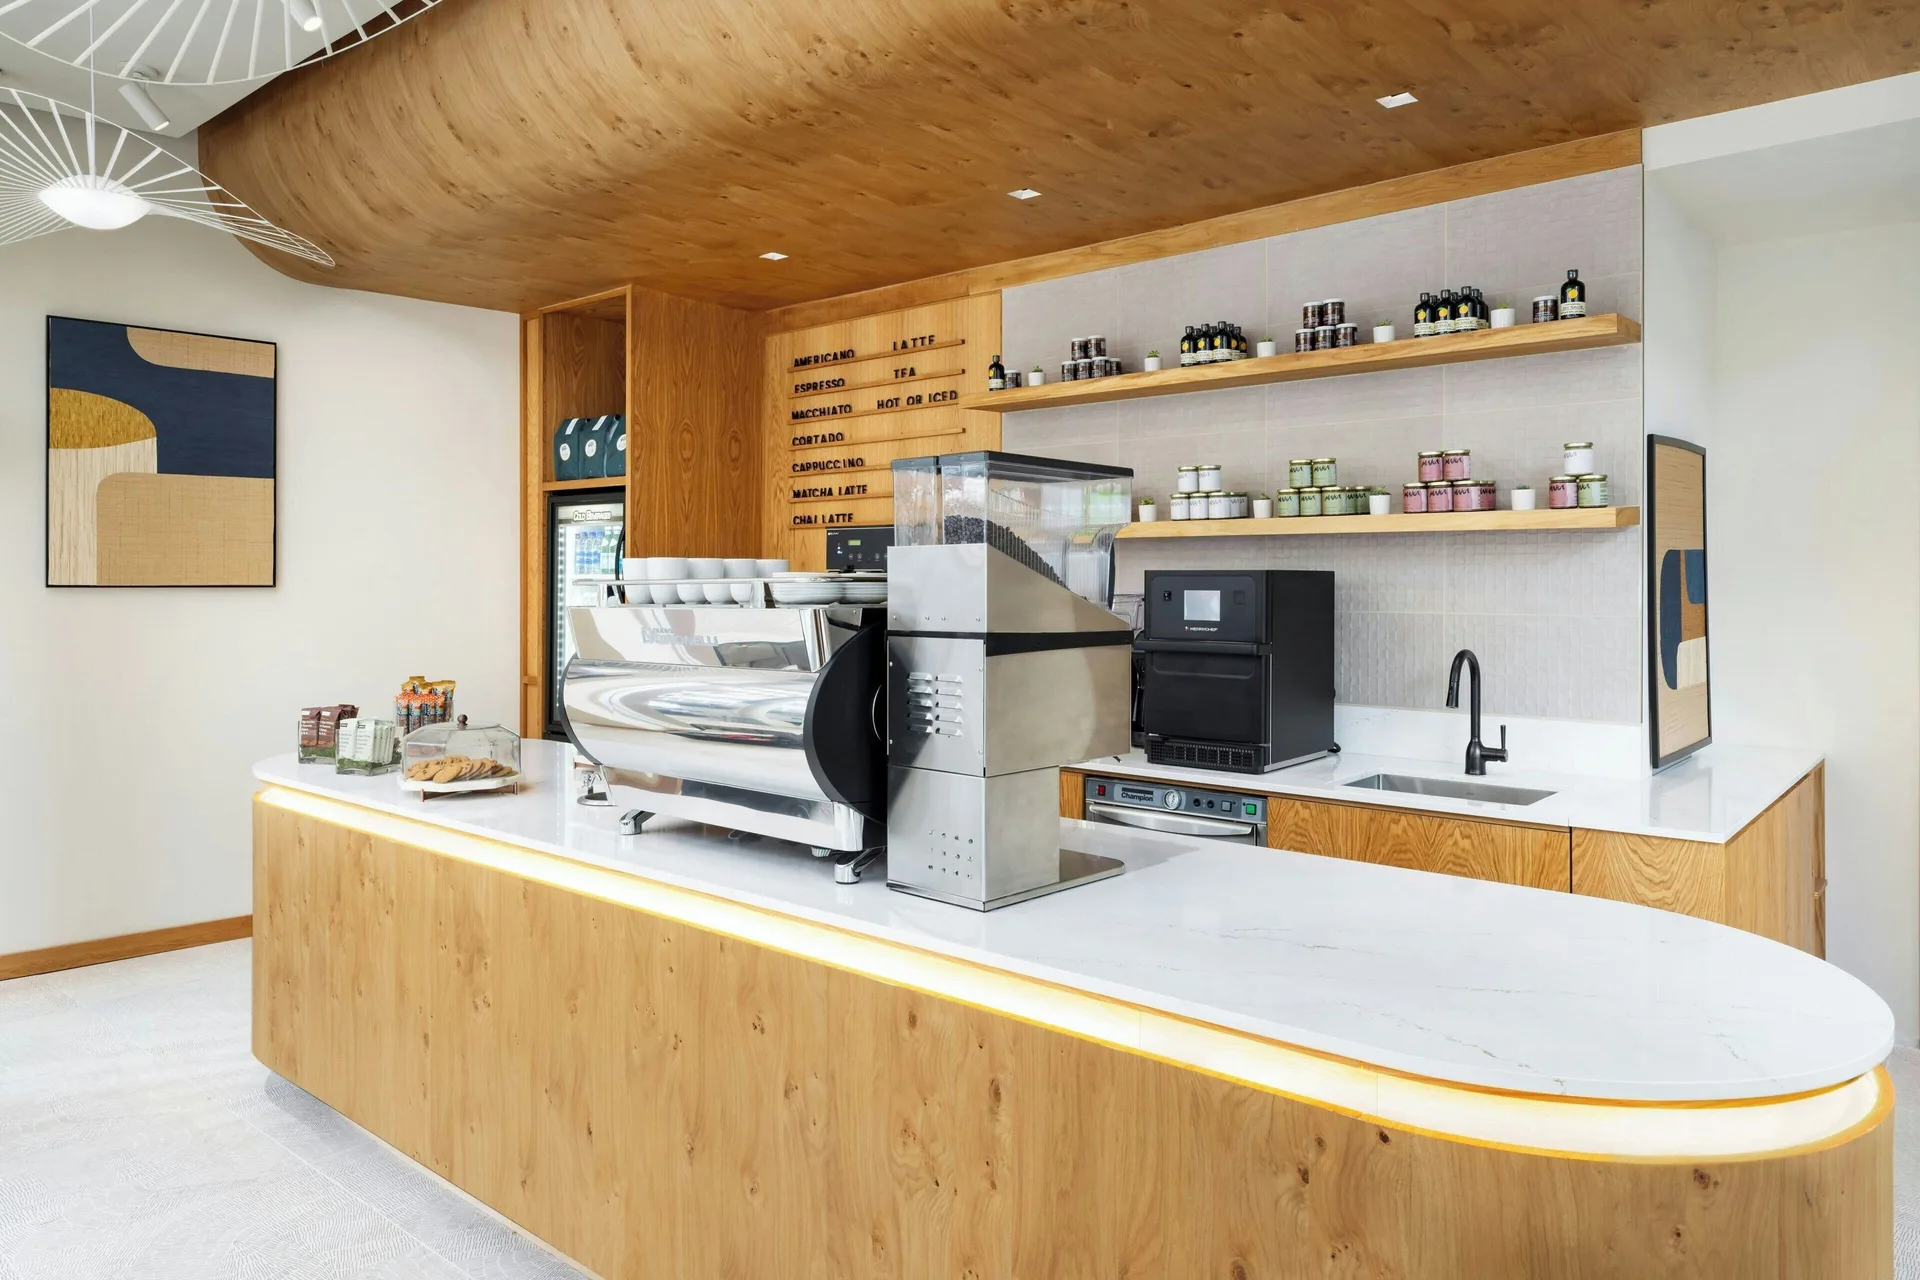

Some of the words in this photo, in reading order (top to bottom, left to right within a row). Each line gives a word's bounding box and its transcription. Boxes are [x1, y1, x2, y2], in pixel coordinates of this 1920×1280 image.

[893, 335, 936, 351] LATTE
[793, 349, 855, 368] AMERICANO
[893, 367, 916, 379] TEA
[794, 378, 845, 394] ESPRESSO
[877, 397, 901, 410] HOT
[906, 394, 922, 406] OR
[928, 390, 958, 403] ICED
[791, 404, 853, 420] MACCHIATO
[792, 432, 845, 447] CORTADO
[792, 457, 865, 473] CAPPUCCINO
[792, 487, 834, 499] MATCHA
[838, 485, 868, 496] LATTE
[792, 514, 818, 525] CHAI
[822, 513, 854, 524] LATTE
[1121, 792, 1154, 802] Champion
